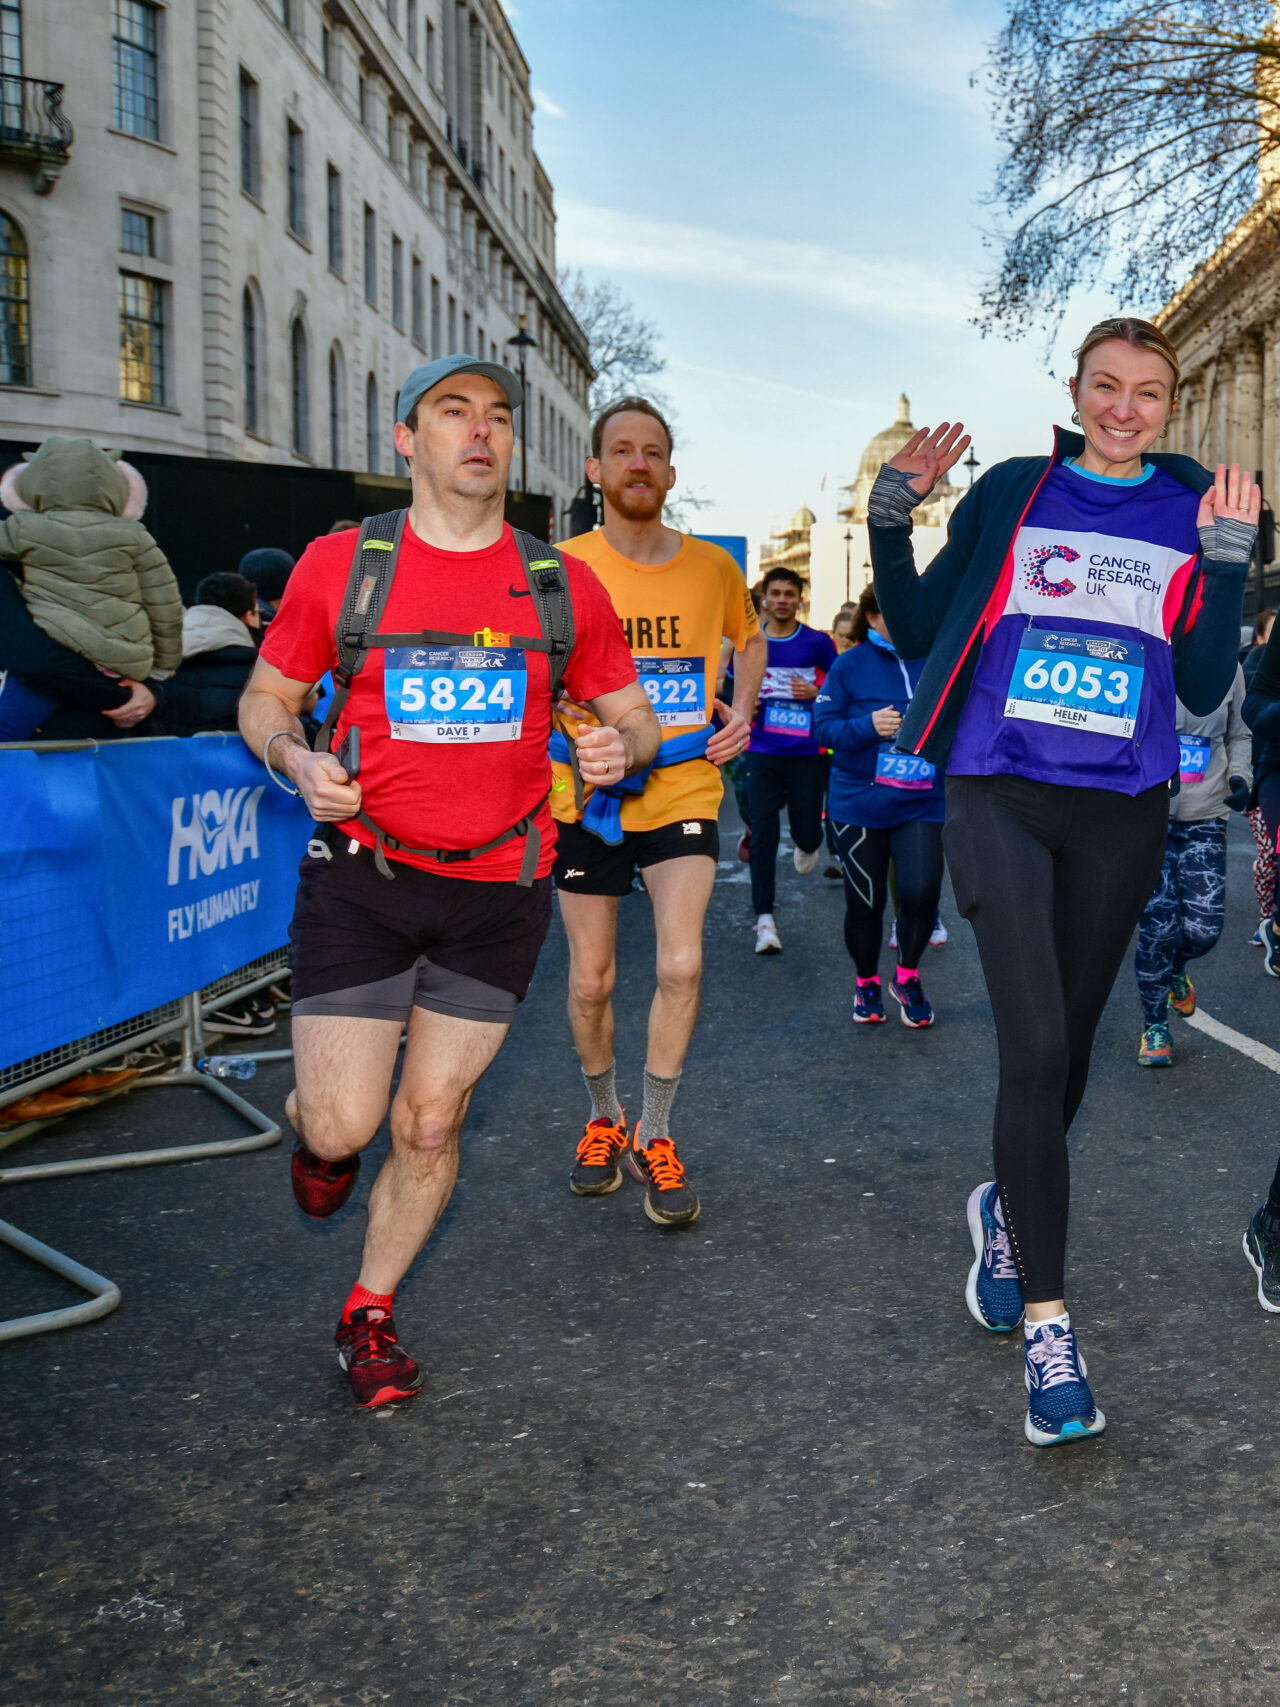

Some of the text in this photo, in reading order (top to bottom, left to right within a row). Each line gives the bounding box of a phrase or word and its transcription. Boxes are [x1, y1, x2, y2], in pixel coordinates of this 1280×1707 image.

[1089, 554, 1151, 575] CANCER
[1086, 582, 1107, 596] UK
[1087, 568, 1162, 595] RESEARCH
[619, 615, 681, 649] HREE
[643, 678, 698, 704] 822
[1023, 658, 1129, 704] 6053
[400, 677, 514, 711] 5824
[769, 710, 807, 726] 8620
[1053, 708, 1088, 723] HELEN
[437, 726, 480, 736] DAVE P
[882, 757, 931, 776] 7576
[1180, 749, 1204, 768] 04
[168, 785, 266, 886] HOKA
[168, 878, 261, 943] FLY HUMAN FLY
